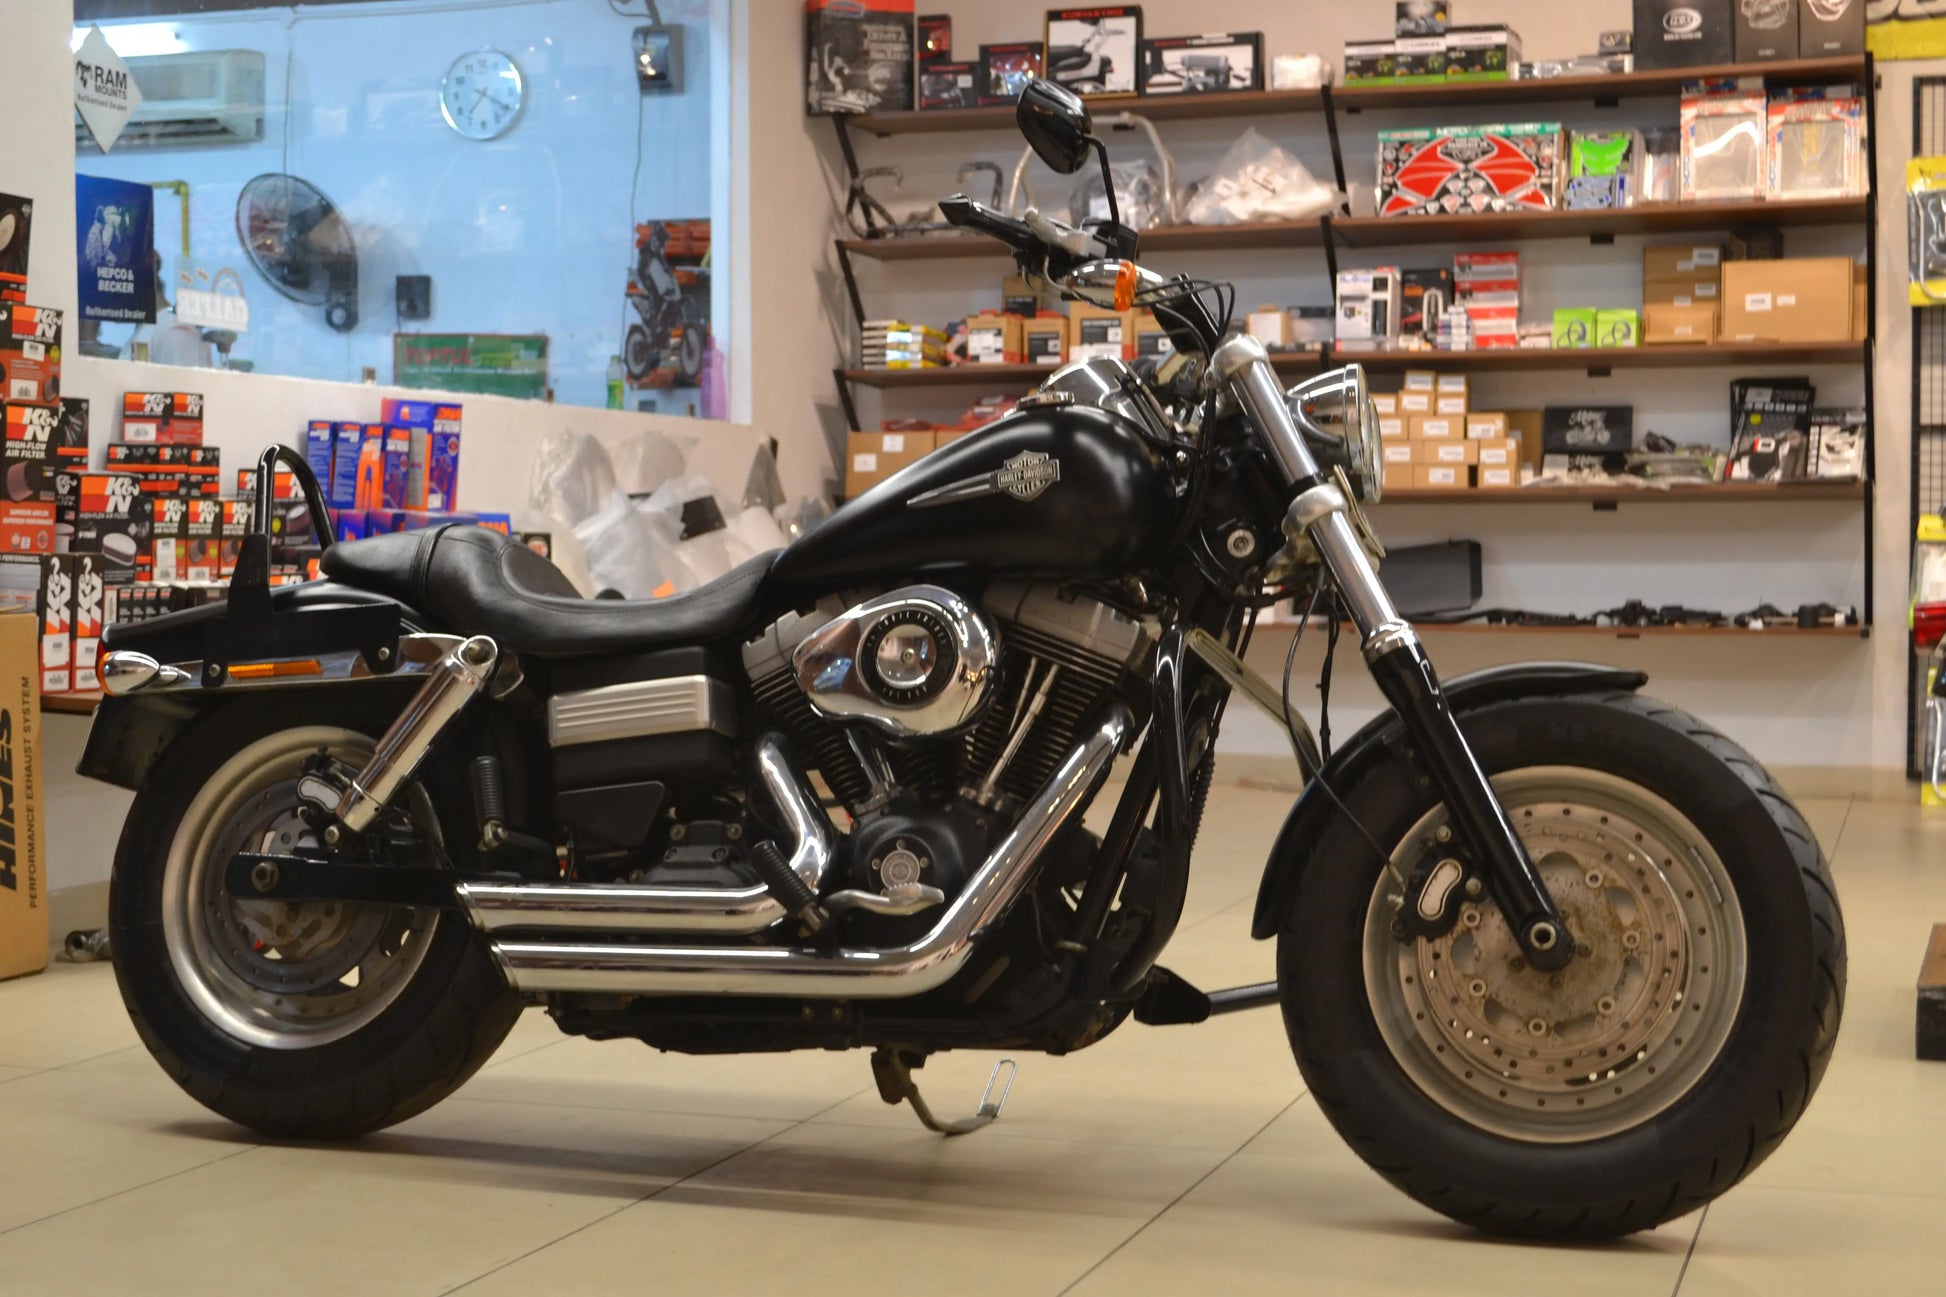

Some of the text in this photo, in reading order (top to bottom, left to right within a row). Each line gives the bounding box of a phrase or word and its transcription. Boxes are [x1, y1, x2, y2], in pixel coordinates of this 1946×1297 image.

[95, 65, 127, 90] RAM
[95, 84, 127, 100] MOUNTS
[97, 266, 127, 280] HEPCO
[98, 279, 134, 293] BECKER
[124, 308, 147, 320] Dealer
[22, 407, 59, 442] K&N
[5, 440, 47, 451] HIGH-FLOW
[5, 449, 46, 459] AIR FILTER
[104, 476, 140, 513] K&N
[163, 499, 187, 522] K&N
[198, 500, 220, 523] K&N
[21, 676, 38, 909] PERFORMANCE EXHAUST SYSTEM
